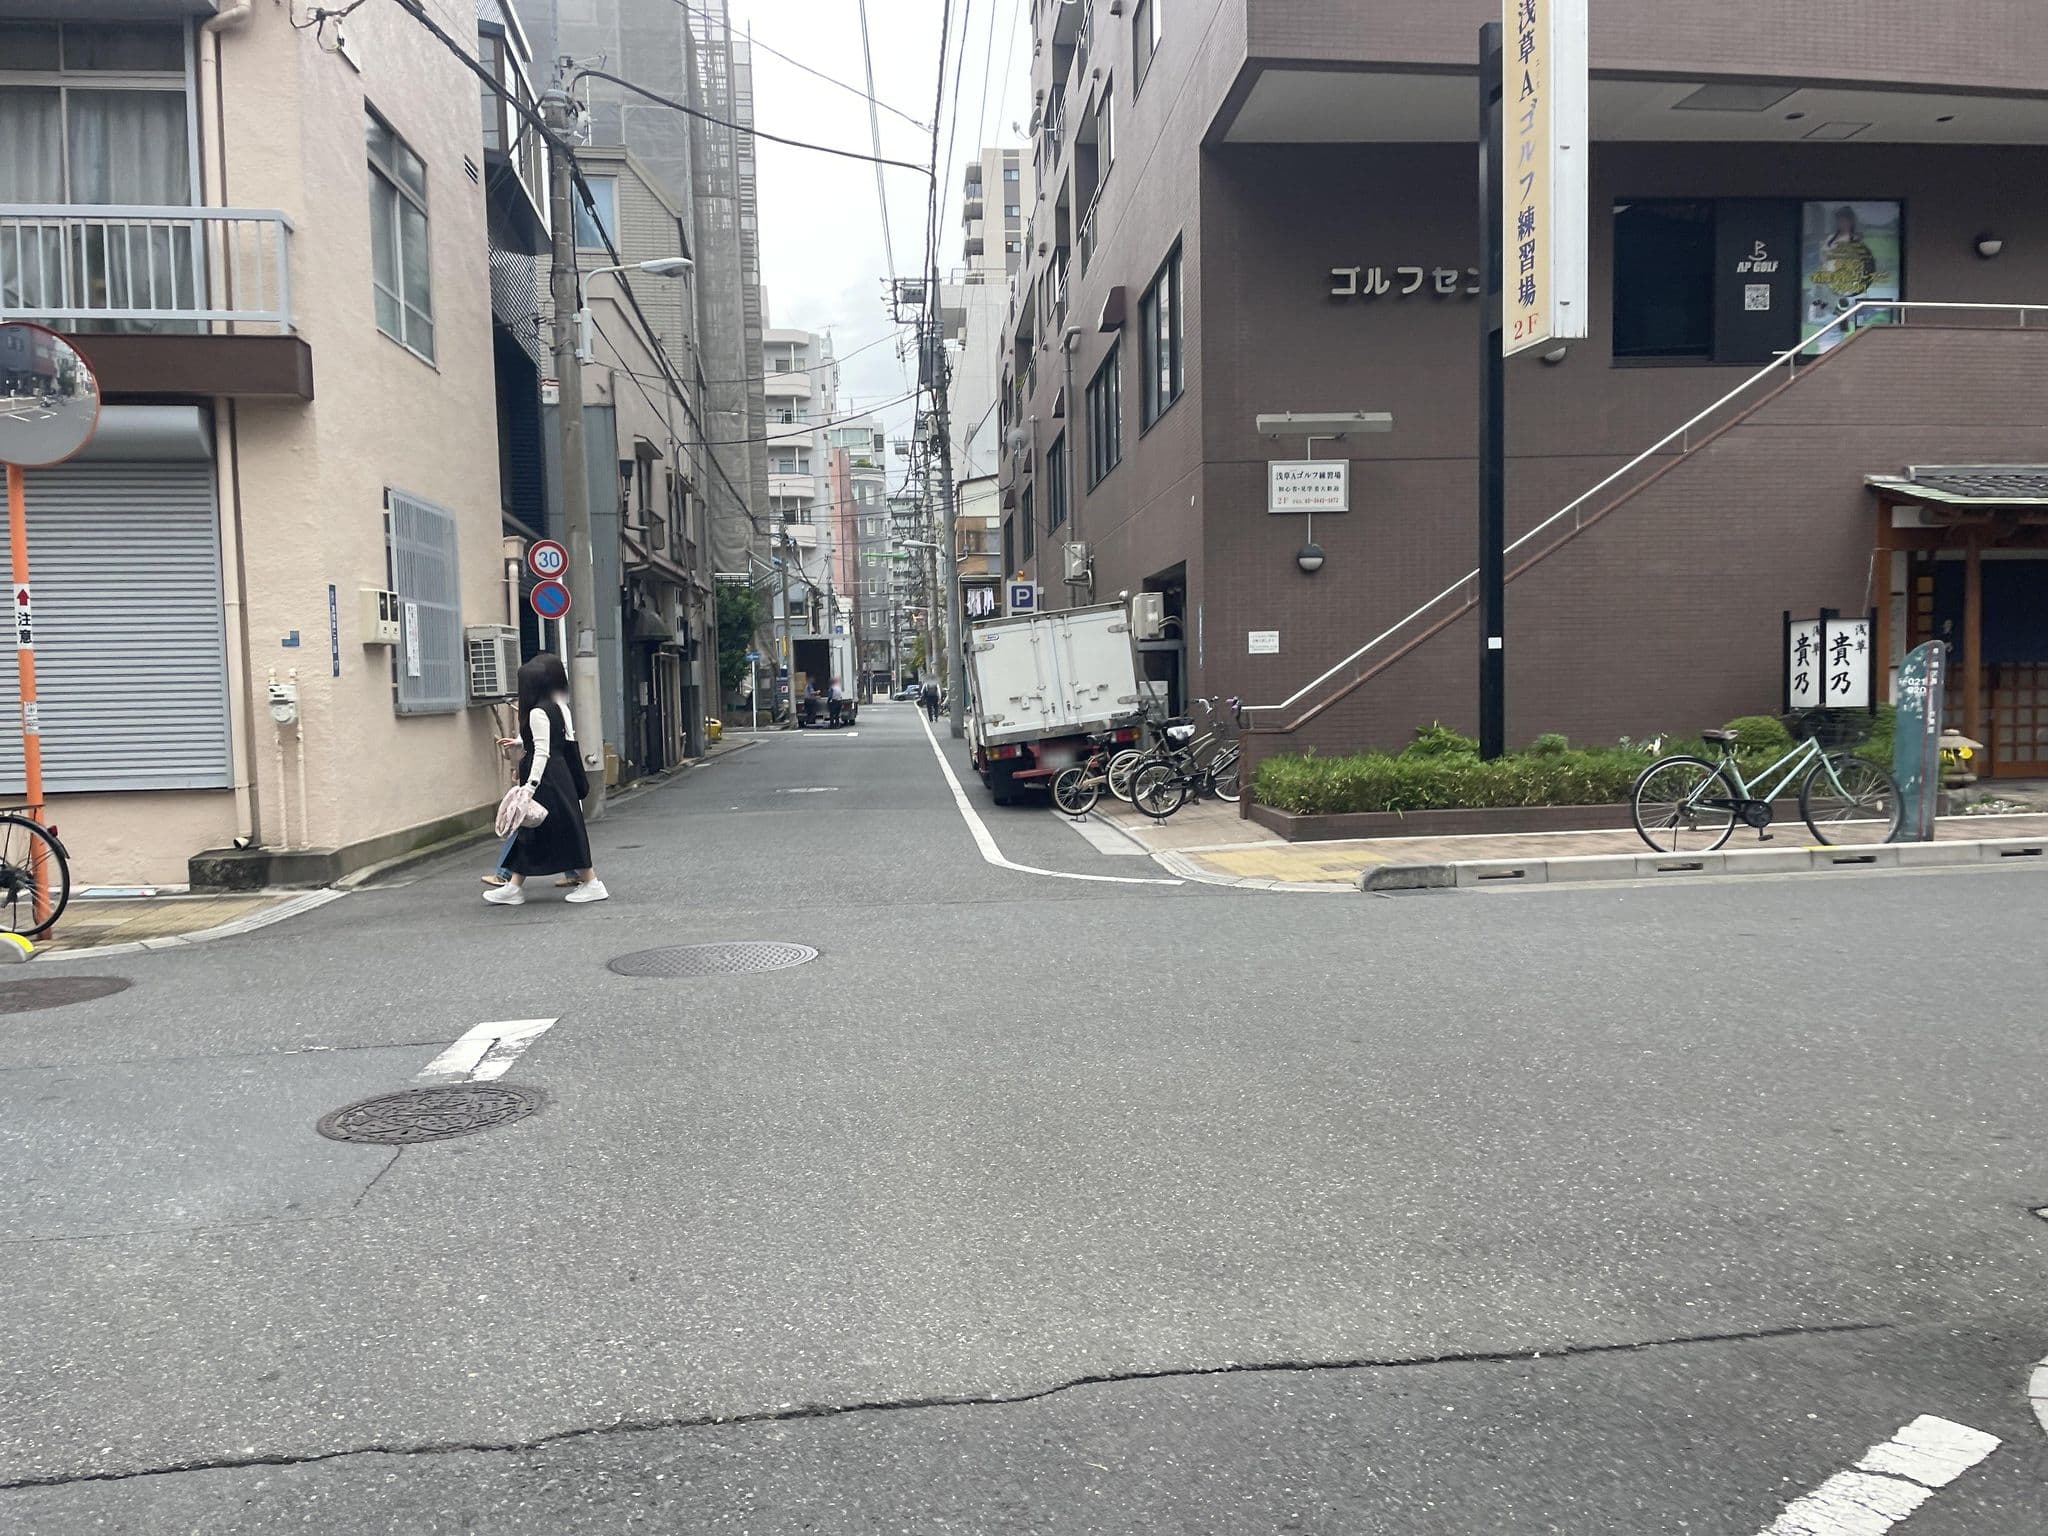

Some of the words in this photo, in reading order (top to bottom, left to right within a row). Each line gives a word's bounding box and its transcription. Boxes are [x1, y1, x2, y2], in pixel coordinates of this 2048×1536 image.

[1737, 261, 1751, 273] AP
[1753, 261, 1779, 273] GOLF
[1514, 313, 1539, 341] 2F
[538, 551, 560, 568] 30
[1016, 588, 1030, 606] P
[17, 612, 32, 644] 注意
[1794, 632, 1812, 695] 貴乃
[1829, 631, 1853, 695] 貴乃
